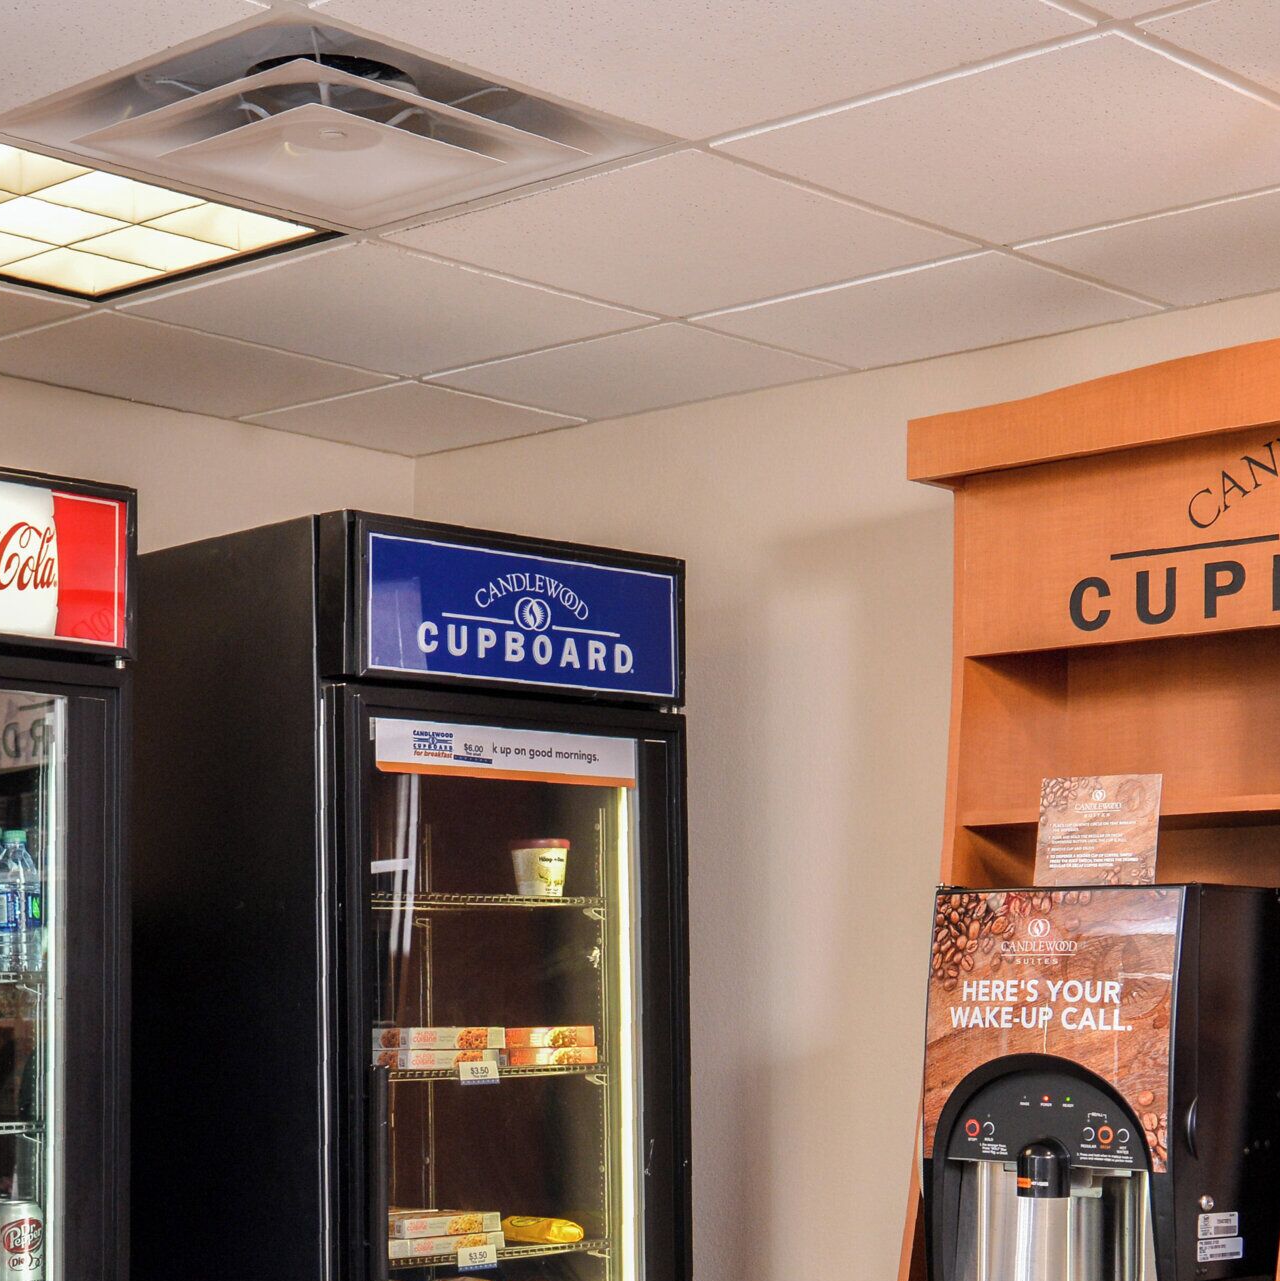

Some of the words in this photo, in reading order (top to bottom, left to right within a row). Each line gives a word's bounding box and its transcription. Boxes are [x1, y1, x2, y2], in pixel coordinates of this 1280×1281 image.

[475, 573, 589, 620] CANDLEWOOD
[417, 621, 634, 674] CUPBOARD
[412, 730, 454, 739] CANDLEWOOD
[412, 743, 454, 752] CUPBOARD
[463, 743, 485, 753] $6.00
[413, 749, 422, 757] for
[422, 750, 453, 759] breakfast
[499, 746, 512, 757] up
[514, 747, 526, 756] on
[528, 746, 553, 760] good
[555, 749, 600, 763] mornings.
[1001, 940, 1078, 952] CANDLEWOOD
[962, 979, 1039, 1003] HERE'S
[1047, 980, 1121, 1004] YOUR
[950, 1006, 1054, 1030] WAKE-UP
[1061, 1007, 1133, 1032] CALL.
[470, 1066, 489, 1075] $3.50
[9, 1227, 43, 1250] Pepper
[468, 1252, 488, 1261] $3.50
